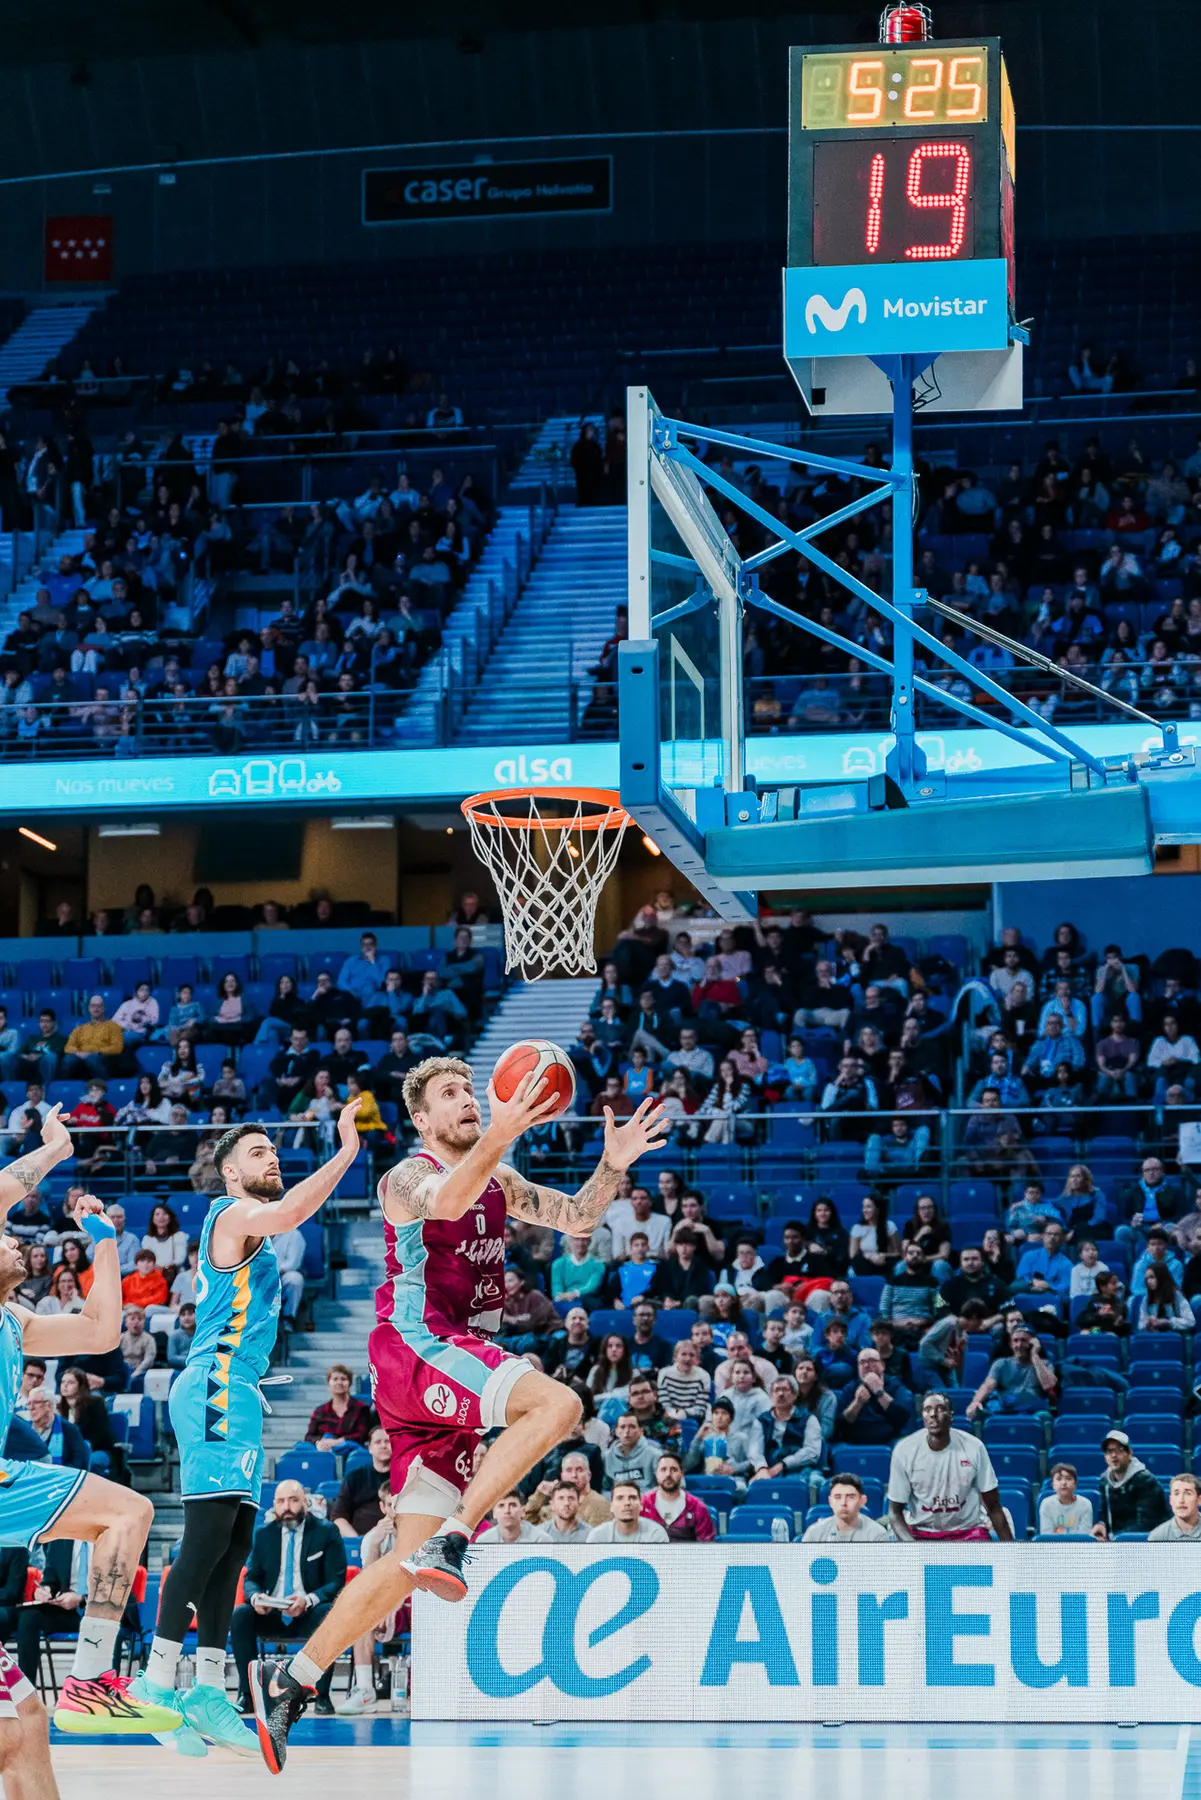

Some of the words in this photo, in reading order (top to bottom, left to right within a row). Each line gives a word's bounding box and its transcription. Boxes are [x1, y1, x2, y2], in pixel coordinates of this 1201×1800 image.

[847, 57, 982, 120] 5:25
[404, 176, 488, 204] caser
[487, 186, 533, 202] Grupo
[866, 143, 970, 259] 19
[883, 296, 988, 319] Movistar
[493, 754, 573, 785] alsa
[55, 778, 95, 795] Nos
[97, 776, 175, 793] mueves
[475, 1213, 487, 1235] 0
